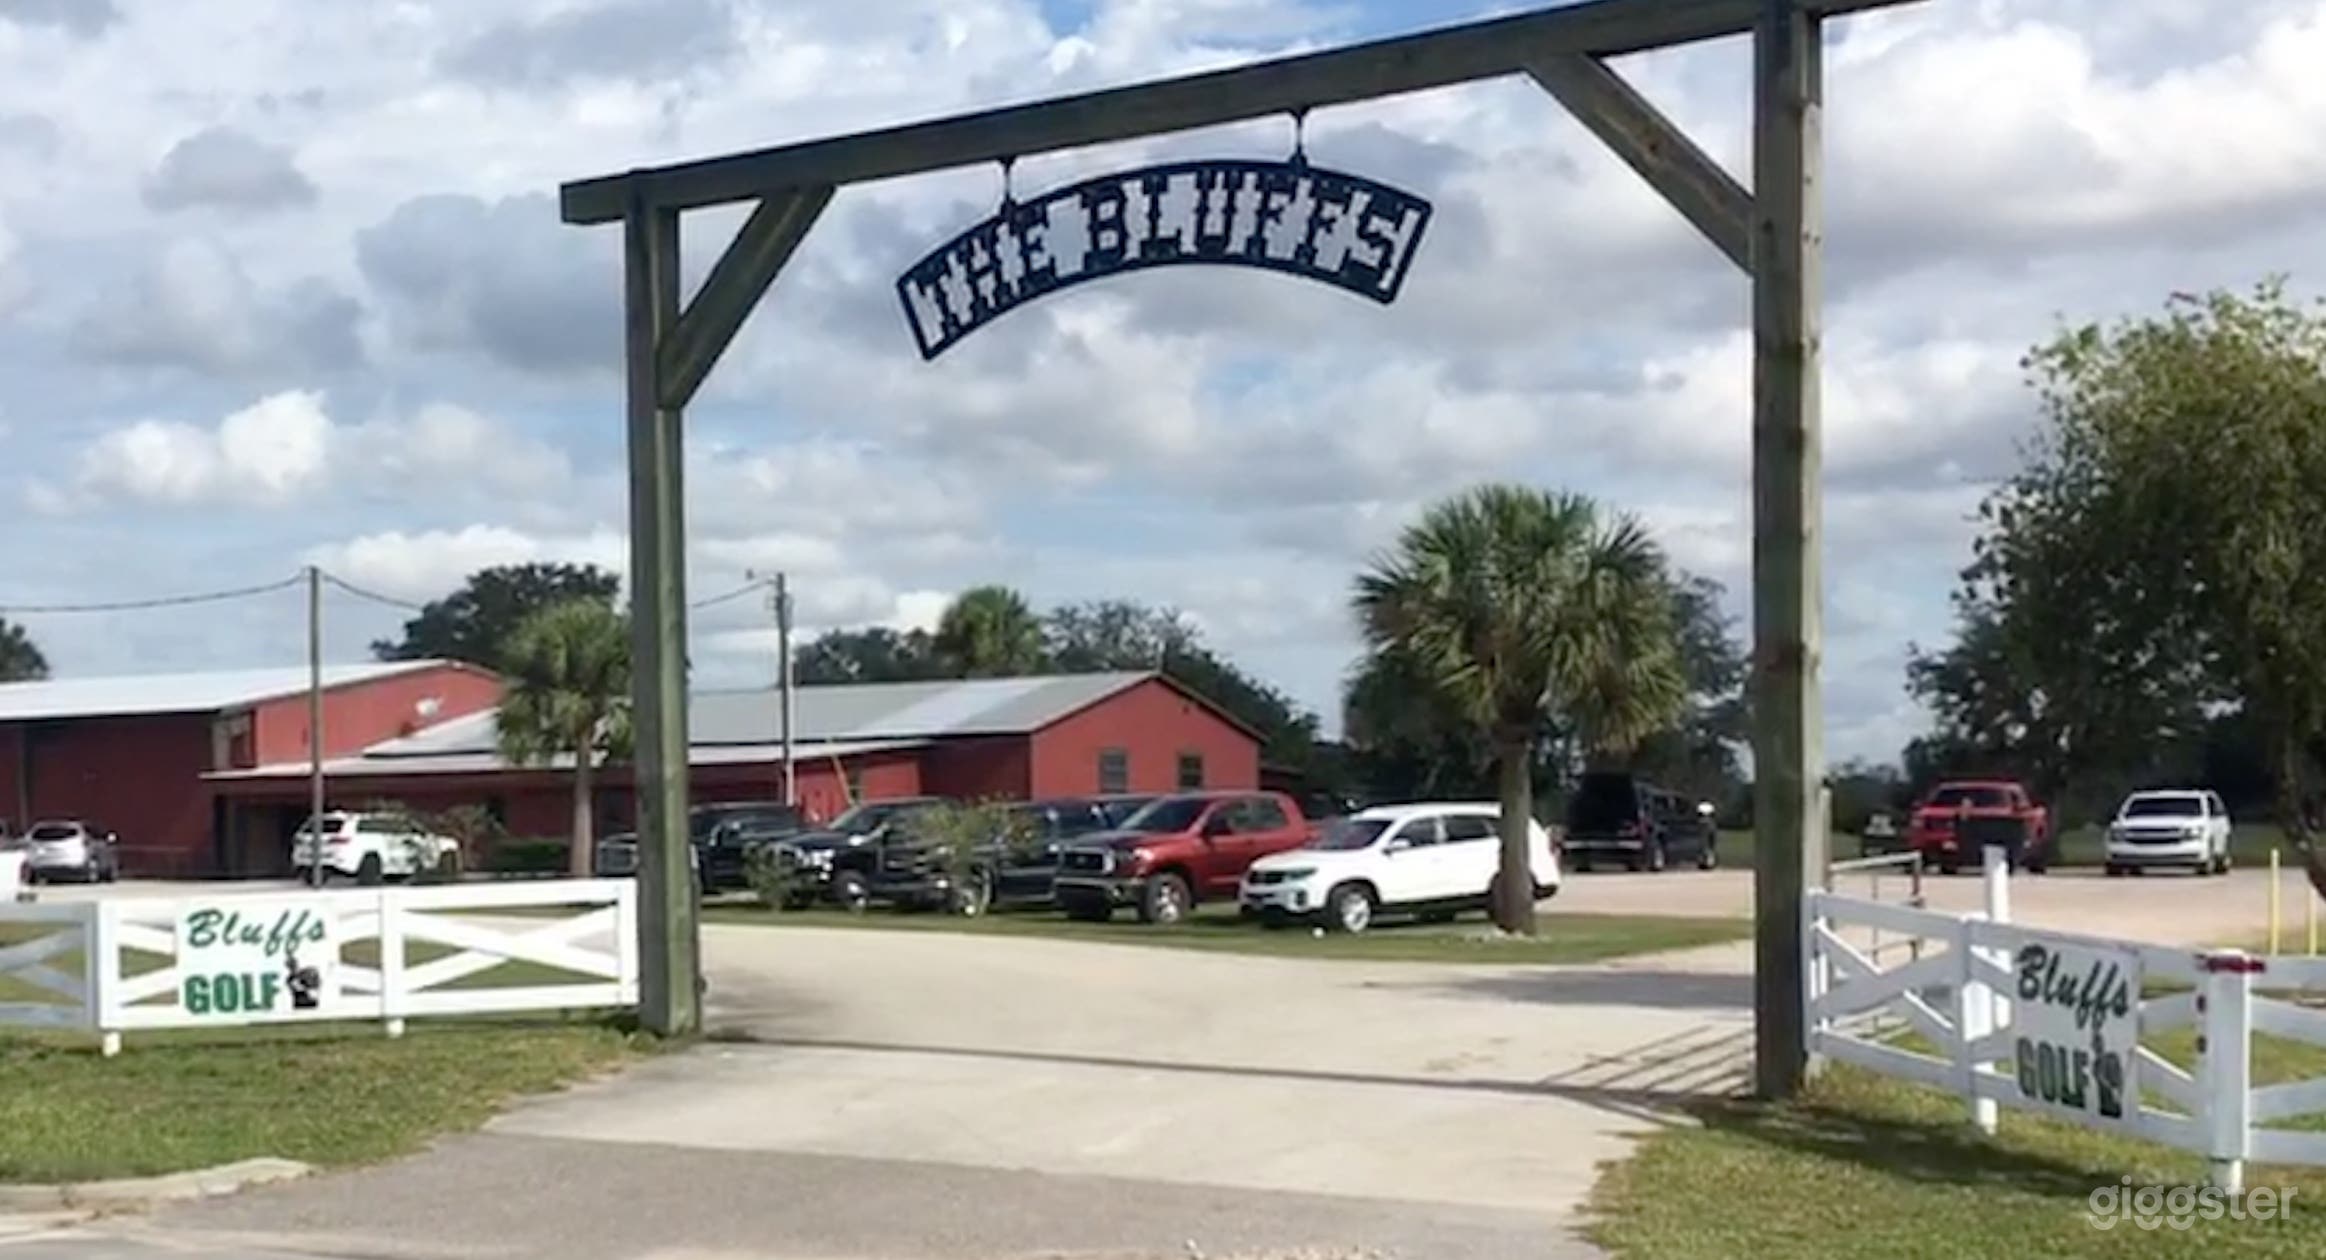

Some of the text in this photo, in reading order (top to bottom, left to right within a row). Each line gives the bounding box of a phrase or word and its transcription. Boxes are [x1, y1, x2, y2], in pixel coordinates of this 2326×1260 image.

[914, 168, 1406, 338] THE BLUFFS
[186, 908, 325, 957] Bluffs
[184, 972, 281, 1014] GOLF
[2015, 944, 2129, 1030] Bluffs
[2017, 1037, 2089, 1109] GOLF
